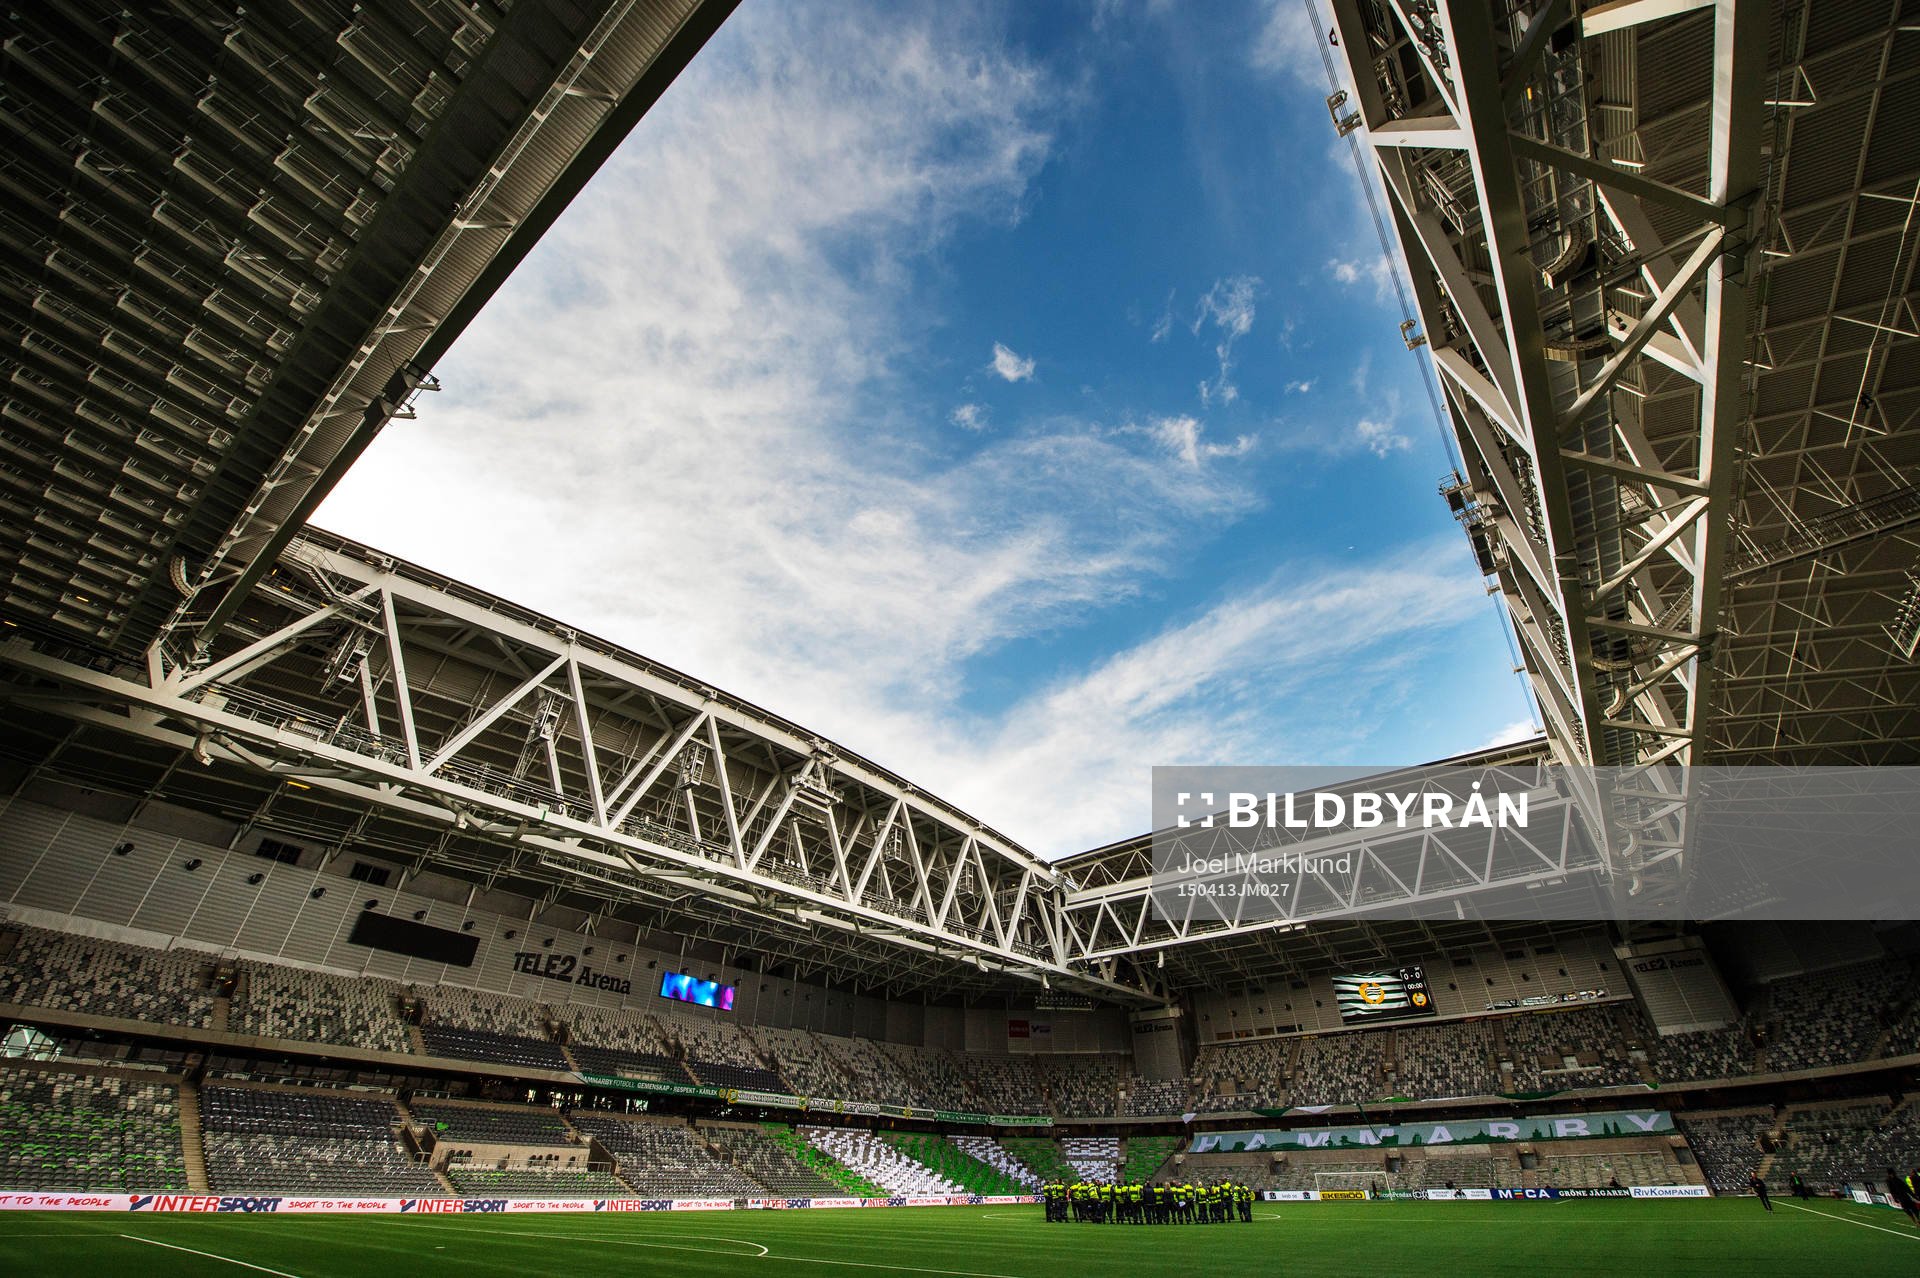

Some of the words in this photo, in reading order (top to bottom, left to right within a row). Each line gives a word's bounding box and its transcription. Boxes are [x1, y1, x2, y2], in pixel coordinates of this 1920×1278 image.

[514, 952, 577, 982] TELE2
[575, 966, 631, 995] Arena
[637, 1082, 670, 1092] GEMENSKAP
[673, 1086, 696, 1094] RESPEKT
[1197, 1113, 1661, 1153] HAMMARBY
[1500, 1188, 1551, 1199] MECA
[1558, 1189, 1588, 1197] GRÖNE
[1589, 1189, 1630, 1197] JÄGAREN
[15, 1196, 34, 1205] TO
[39, 1197, 62, 1206] THE
[67, 1197, 112, 1206] PEOPLE
[153, 1195, 283, 1212] INTERSPORT
[321, 1201, 334, 1209] TO
[337, 1201, 353, 1209] THE
[417, 1199, 508, 1213] INTERSPORT
[606, 1199, 673, 1212] INTERSPORT
[762, 1198, 812, 1210] INTERSPORT
[867, 1196, 907, 1207] INTERSPORT
